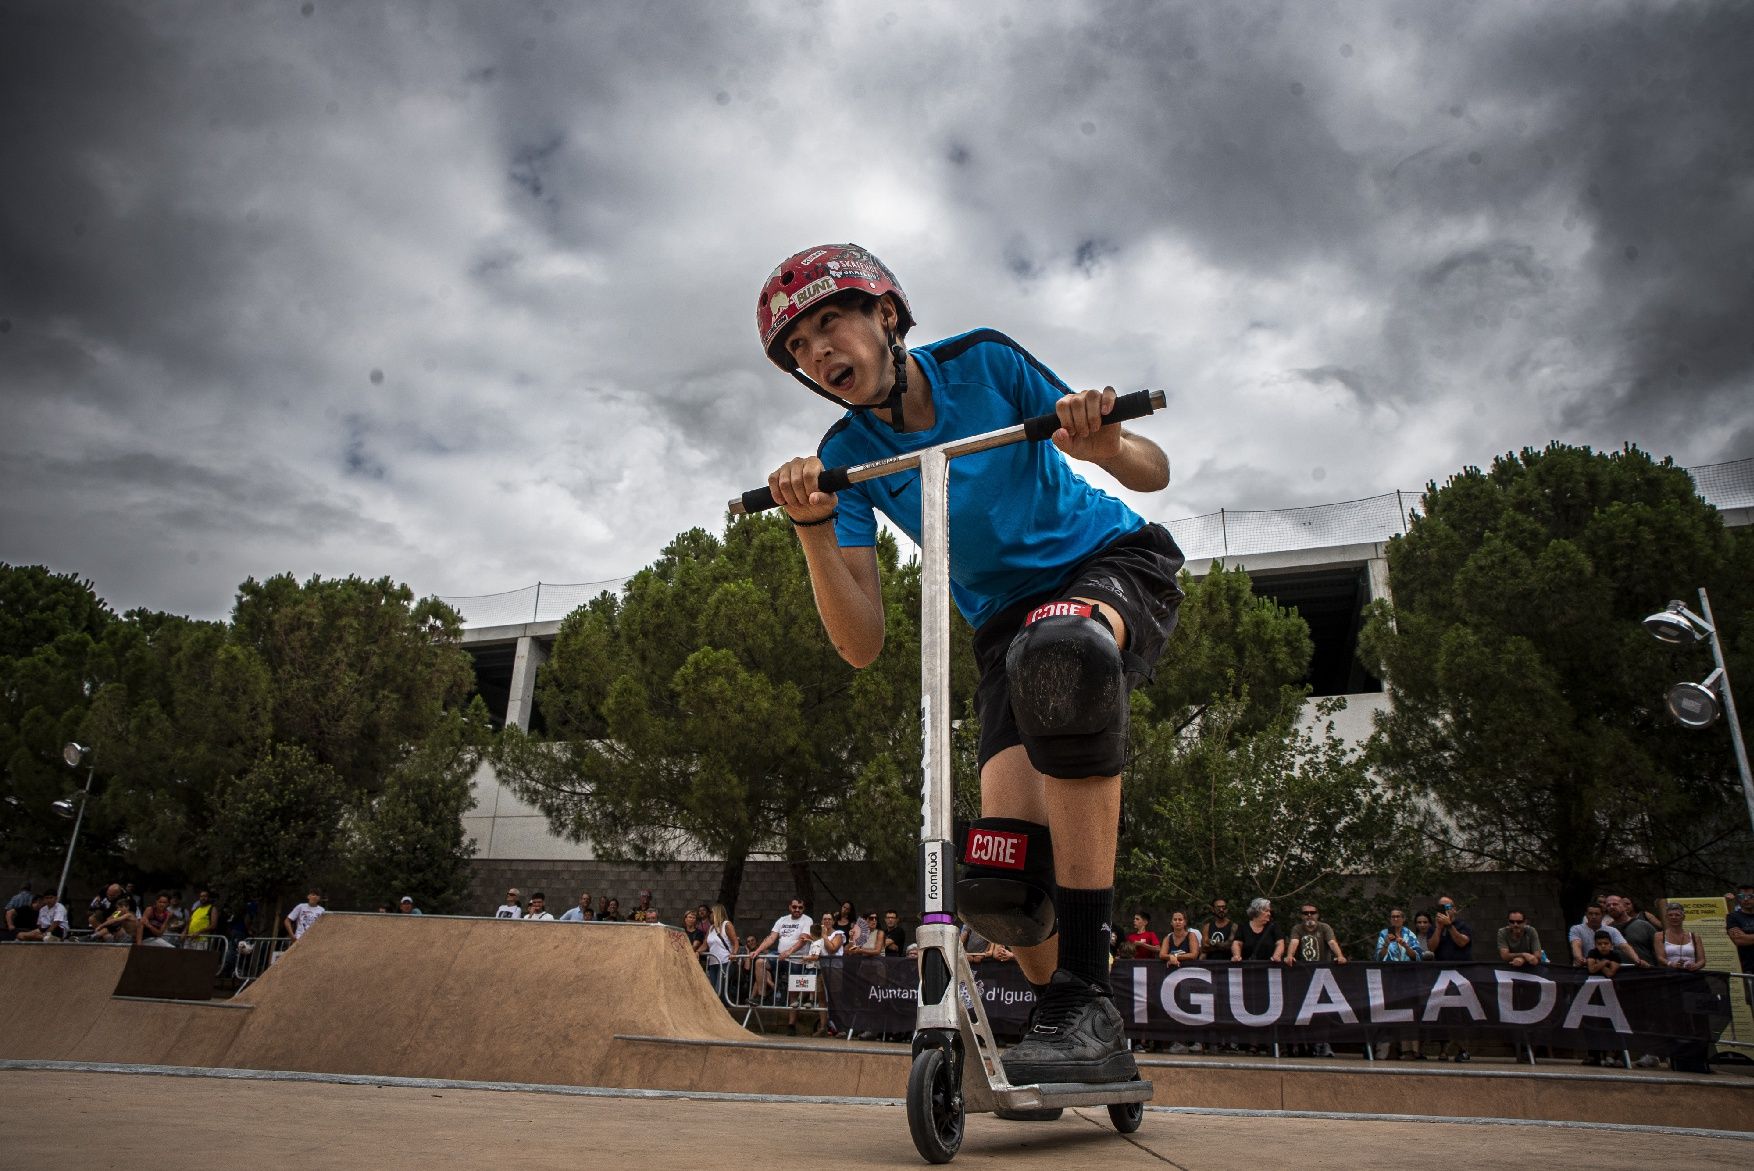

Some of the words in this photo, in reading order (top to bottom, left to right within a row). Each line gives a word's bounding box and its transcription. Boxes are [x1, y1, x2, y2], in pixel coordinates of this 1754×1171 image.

[797, 279, 832, 305] BLUNT
[1032, 604, 1082, 623] CORE
[971, 833, 1018, 864] CORE
[868, 985, 918, 1002] Ajuntam
[1133, 966, 1633, 1034] IGUALADA
